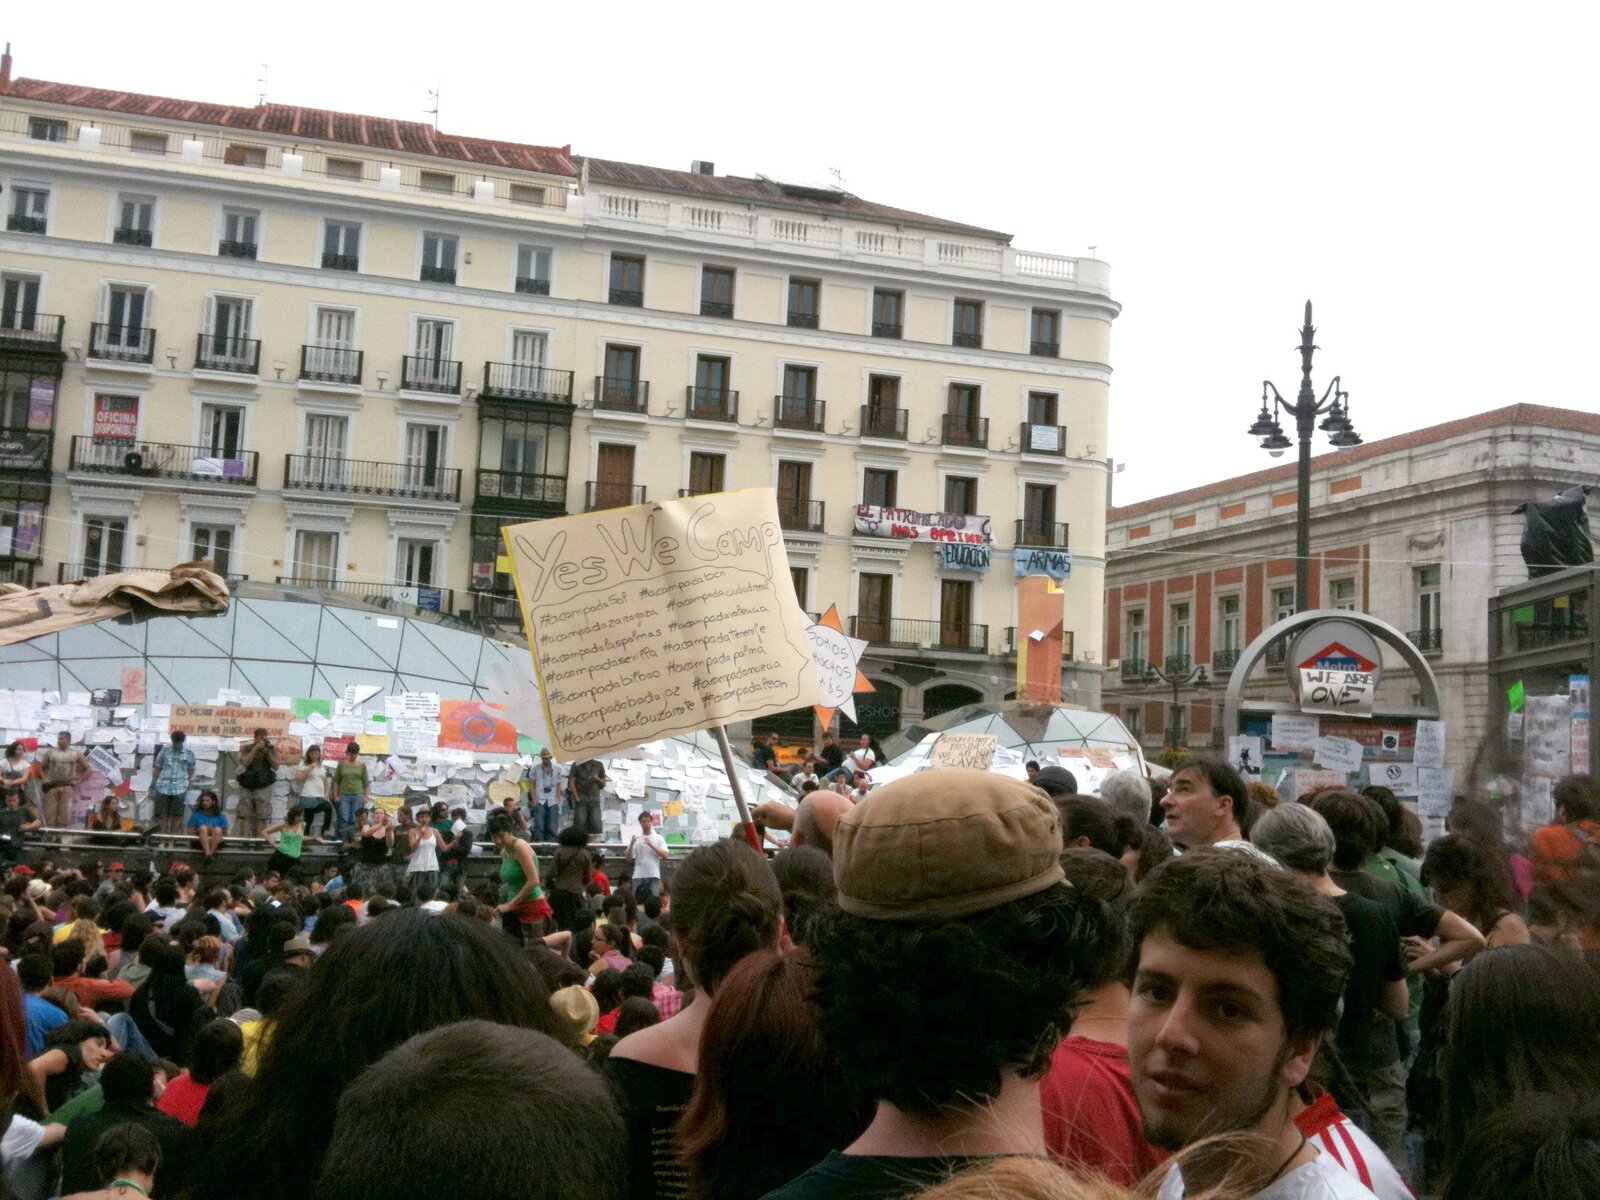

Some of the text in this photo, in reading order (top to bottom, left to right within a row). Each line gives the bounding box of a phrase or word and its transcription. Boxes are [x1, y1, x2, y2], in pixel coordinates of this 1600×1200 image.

[95, 422, 137, 437] DISPONIBLE
[97, 411, 137, 424] OFICINA
[857, 504, 874, 519] EL
[891, 523, 982, 544] NOS OPRIME
[515, 503, 780, 602] Yes We Camp
[639, 570, 726, 600] #acampadabcn
[541, 609, 659, 645] #acampadazaragoza
[541, 629, 662, 668] #acampadalaspalmas
[808, 631, 848, 660] SOMOS
[550, 644, 767, 704] #acampadabilbao #acampadapalma
[812, 651, 852, 679] MUCHOS
[1316, 661, 1357, 671] Metro
[1307, 671, 1374, 684] WE ARE
[1311, 685, 1366, 705] ONE
[554, 686, 681, 731] #acampadabadajoz
[941, 757, 987, 770] SLAVES
